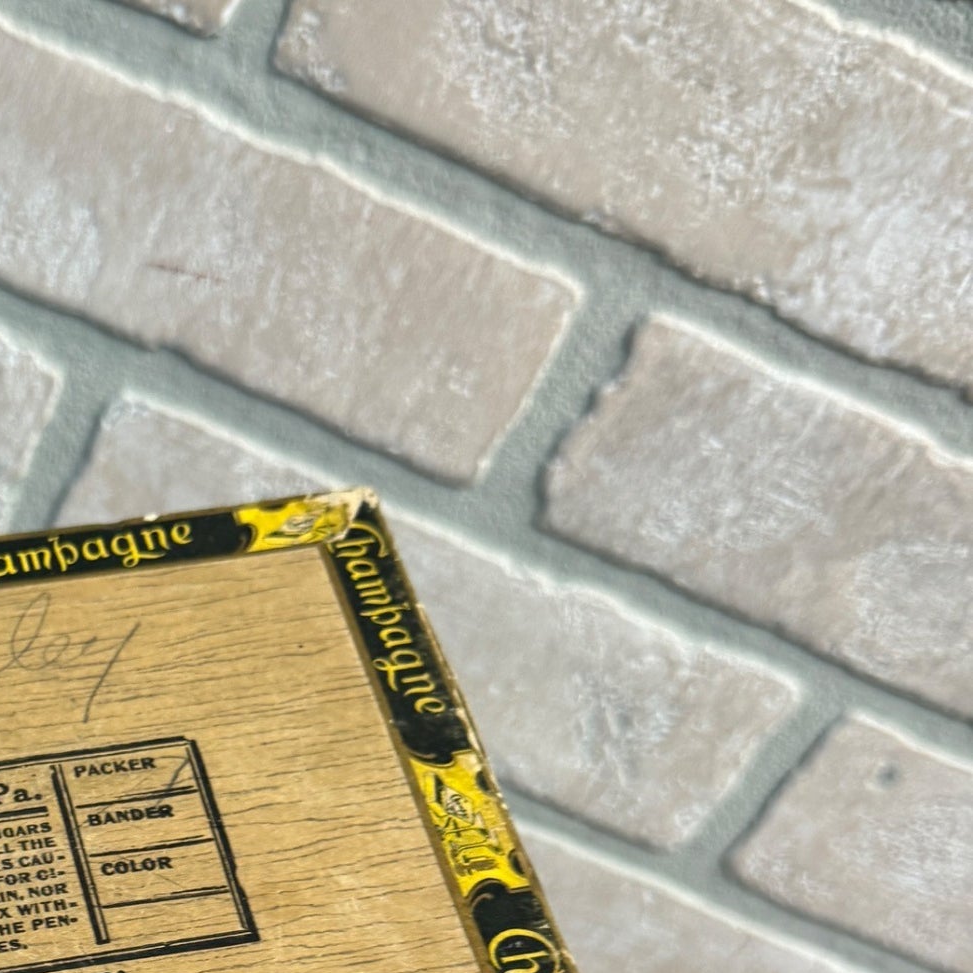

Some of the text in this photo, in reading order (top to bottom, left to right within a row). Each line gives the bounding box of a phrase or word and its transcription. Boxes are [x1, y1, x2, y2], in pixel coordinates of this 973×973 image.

[326, 520, 447, 714] Champagne
[73, 757, 156, 778] PACKER
[87, 804, 175, 827] BANDER
[17, 836, 57, 851] THE
[100, 856, 173, 876] COLOR
[27, 882, 69, 898] NOR
